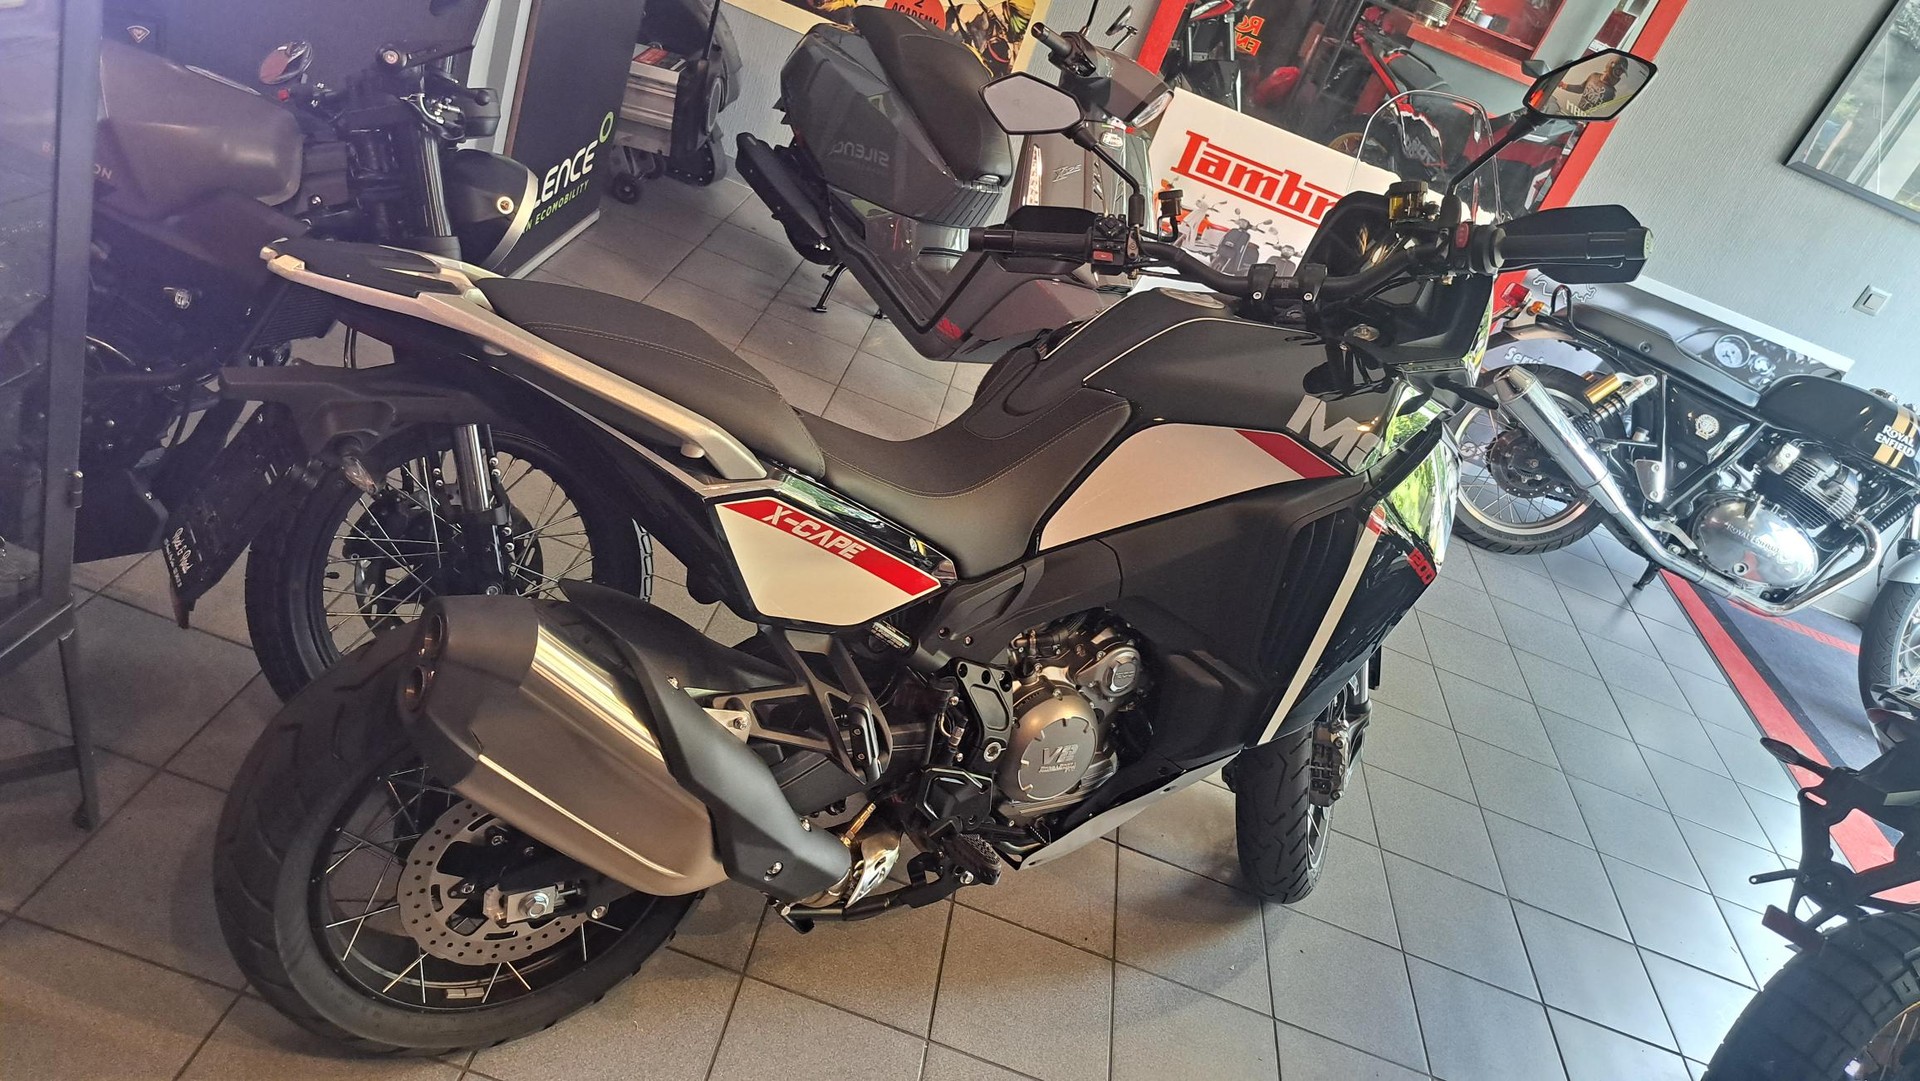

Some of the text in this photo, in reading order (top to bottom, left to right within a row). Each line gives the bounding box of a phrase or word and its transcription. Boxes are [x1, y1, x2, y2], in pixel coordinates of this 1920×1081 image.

[534, 179, 590, 225] ECOMOBILITY
[1874, 432, 1916, 458] ENFIELD
[1882, 424, 1915, 448] ROYAL
[761, 504, 868, 560] X-CAPE
[1727, 523, 1751, 541] ROYAL
